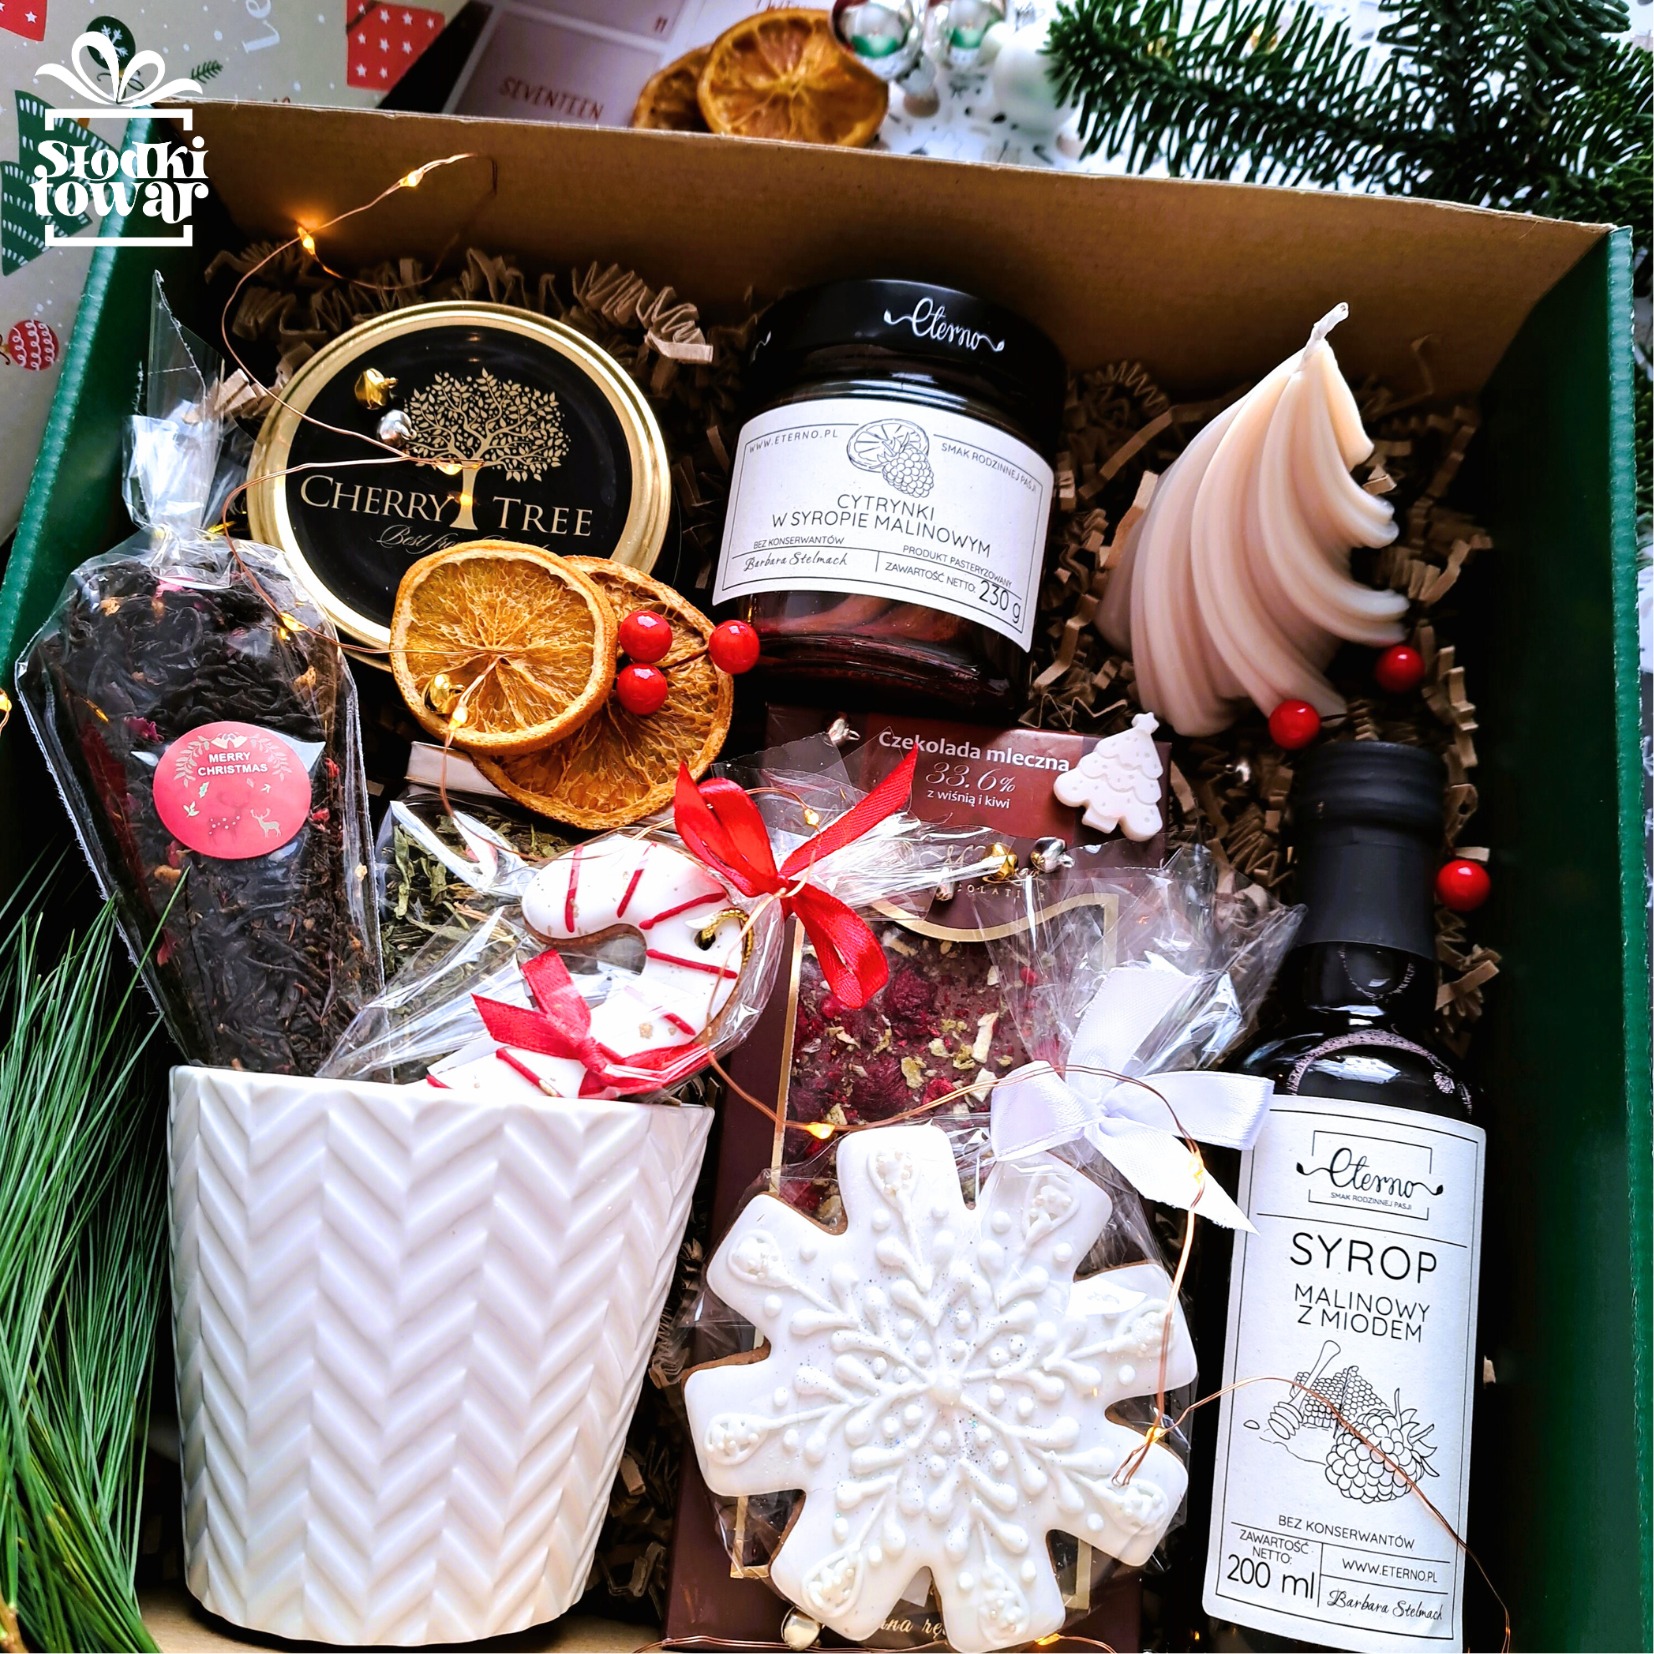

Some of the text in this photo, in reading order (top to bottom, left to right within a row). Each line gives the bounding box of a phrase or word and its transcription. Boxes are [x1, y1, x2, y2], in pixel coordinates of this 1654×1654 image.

[498, 76, 604, 121] SEVENTEEN
[749, 429, 838, 453] WWW.ETERNO.PL
[941, 442, 970, 459] SMAK
[971, 451, 1020, 481] RODZINNEJ
[300, 475, 593, 537] CHERRY TREE
[837, 494, 935, 521] CYTRYNKI
[376, 524, 433, 549] Best
[406, 533, 461, 554] fro
[753, 534, 845, 550] BEZ KONSERWANTÓW
[772, 510, 991, 558] W SYROPIE MALINOWYM
[743, 550, 848, 572] Barbara Stelmach
[884, 562, 944, 583] ZAWARTOŚĆ
[902, 545, 1012, 589] PRODUKT PASTERYZOWANY
[979, 579, 1022, 624] 230 g
[208, 752, 251, 763] MERRY
[878, 731, 1071, 773] Czekolada mleczna
[197, 764, 269, 776] CHRISTMAS
[925, 761, 1017, 793] 33.6%
[927, 789, 1011, 809] z wiśnią i kiwi
[1330, 1192, 1413, 1211] SMAK RODZINNEJ PASJI
[1289, 1232, 1437, 1284] SYROP
[1294, 1283, 1430, 1323] MALINOWY
[1297, 1304, 1422, 1343] Z MIODEM
[1239, 1529, 1310, 1555] ZAWARTOŚĆ
[1278, 1514, 1415, 1550] BEZ KONSERWANTÓW
[1252, 1546, 1293, 1565] NETTO:
[1341, 1557, 1438, 1583] WWW.ETERNO.PL
[1226, 1553, 1316, 1600] 200 ml
[1326, 1588, 1443, 1621] Barbara Stelmach
